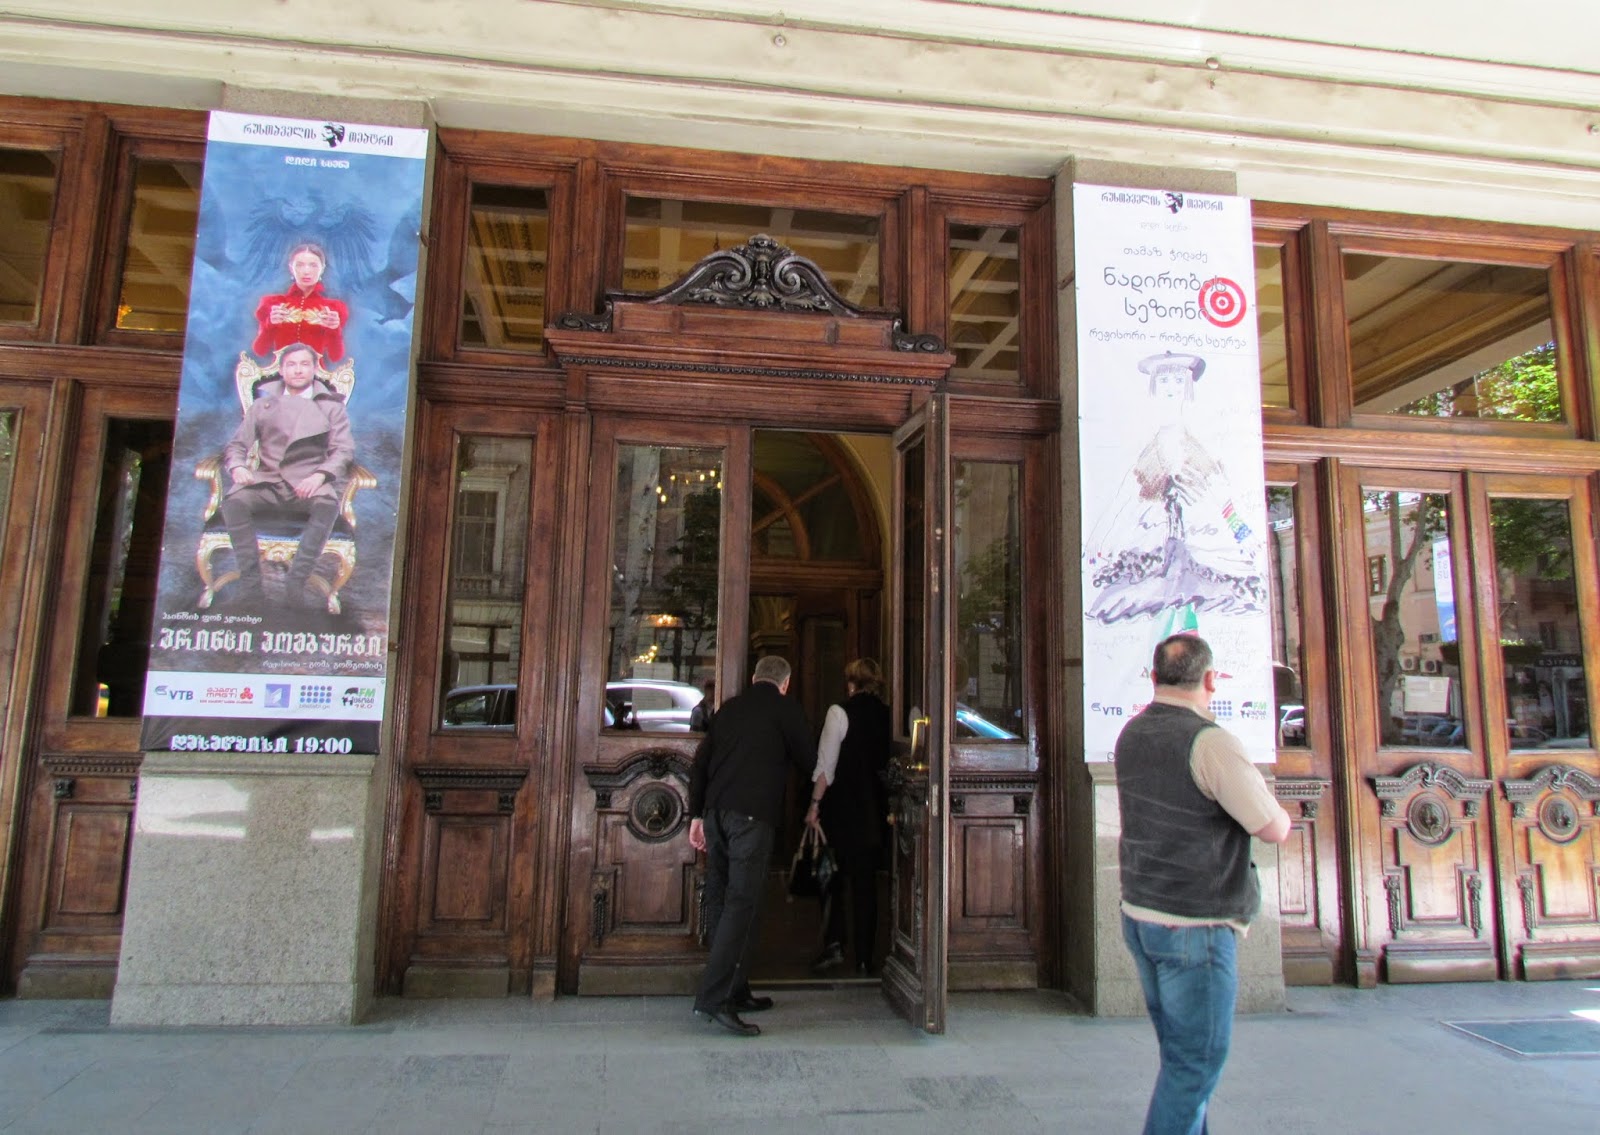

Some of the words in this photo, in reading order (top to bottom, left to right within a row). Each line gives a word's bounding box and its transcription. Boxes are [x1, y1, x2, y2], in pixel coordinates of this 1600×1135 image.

[243, 123, 317, 139] რუსთაველის
[348, 131, 394, 146] თეატრი
[1101, 192, 1161, 206] რუსთაველის
[1186, 198, 1224, 211] თეატრი
[1123, 245, 1163, 257] თამაზ
[1169, 249, 1208, 264] ჭილაძე
[1103, 266, 1227, 294] ნადირობის
[1089, 327, 1146, 342] რეჟისორი
[1159, 331, 1203, 347] რობერტ
[1205, 331, 1247, 350] სტურუა
[202, 613, 222, 623] ფონ
[160, 627, 254, 653] პრინცი
[170, 689, 194, 701] VTB
[359, 687, 376, 697] FM
[1102, 706, 1123, 716] VTB
[295, 737, 353, 754] 19:00
